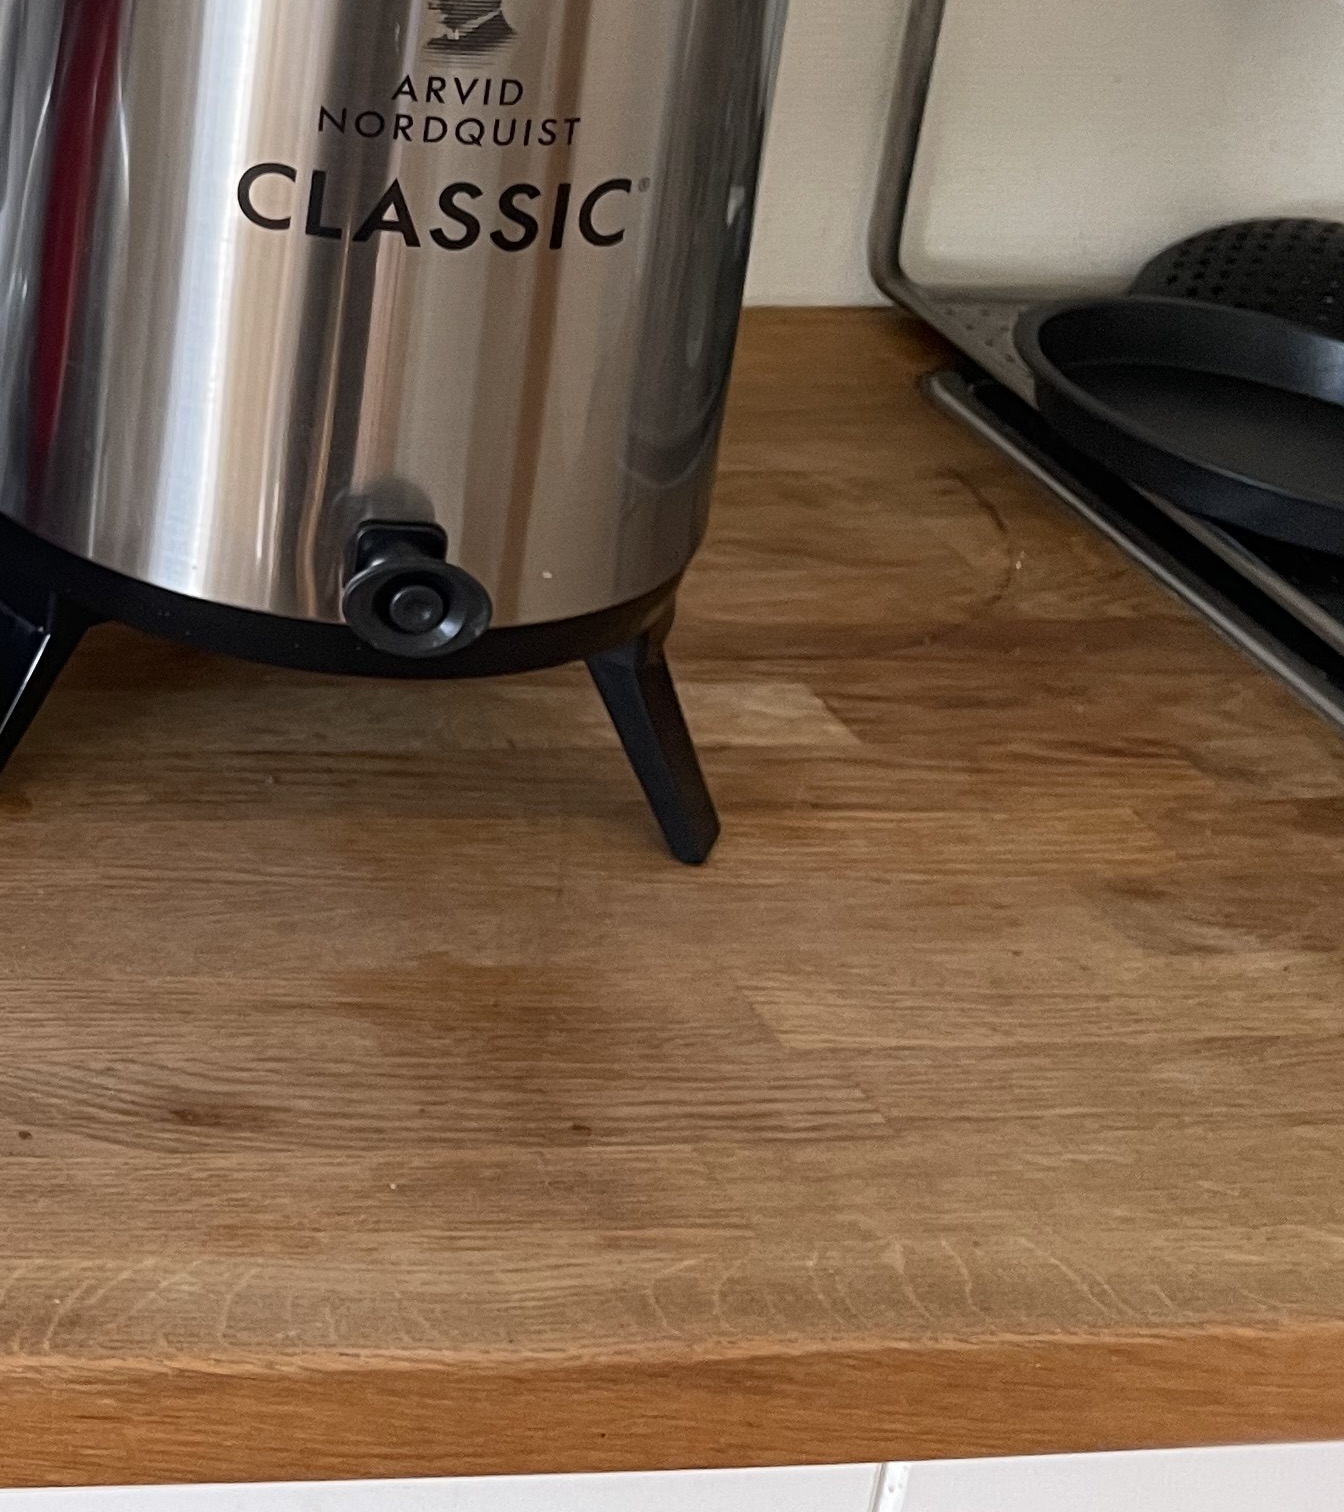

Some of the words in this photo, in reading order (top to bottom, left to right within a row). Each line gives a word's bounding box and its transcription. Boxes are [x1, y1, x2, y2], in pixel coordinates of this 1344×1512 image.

[392, 75, 524, 106] ARVID
[317, 106, 581, 147] NORDQUIST
[237, 162, 633, 252] CLASSIC
